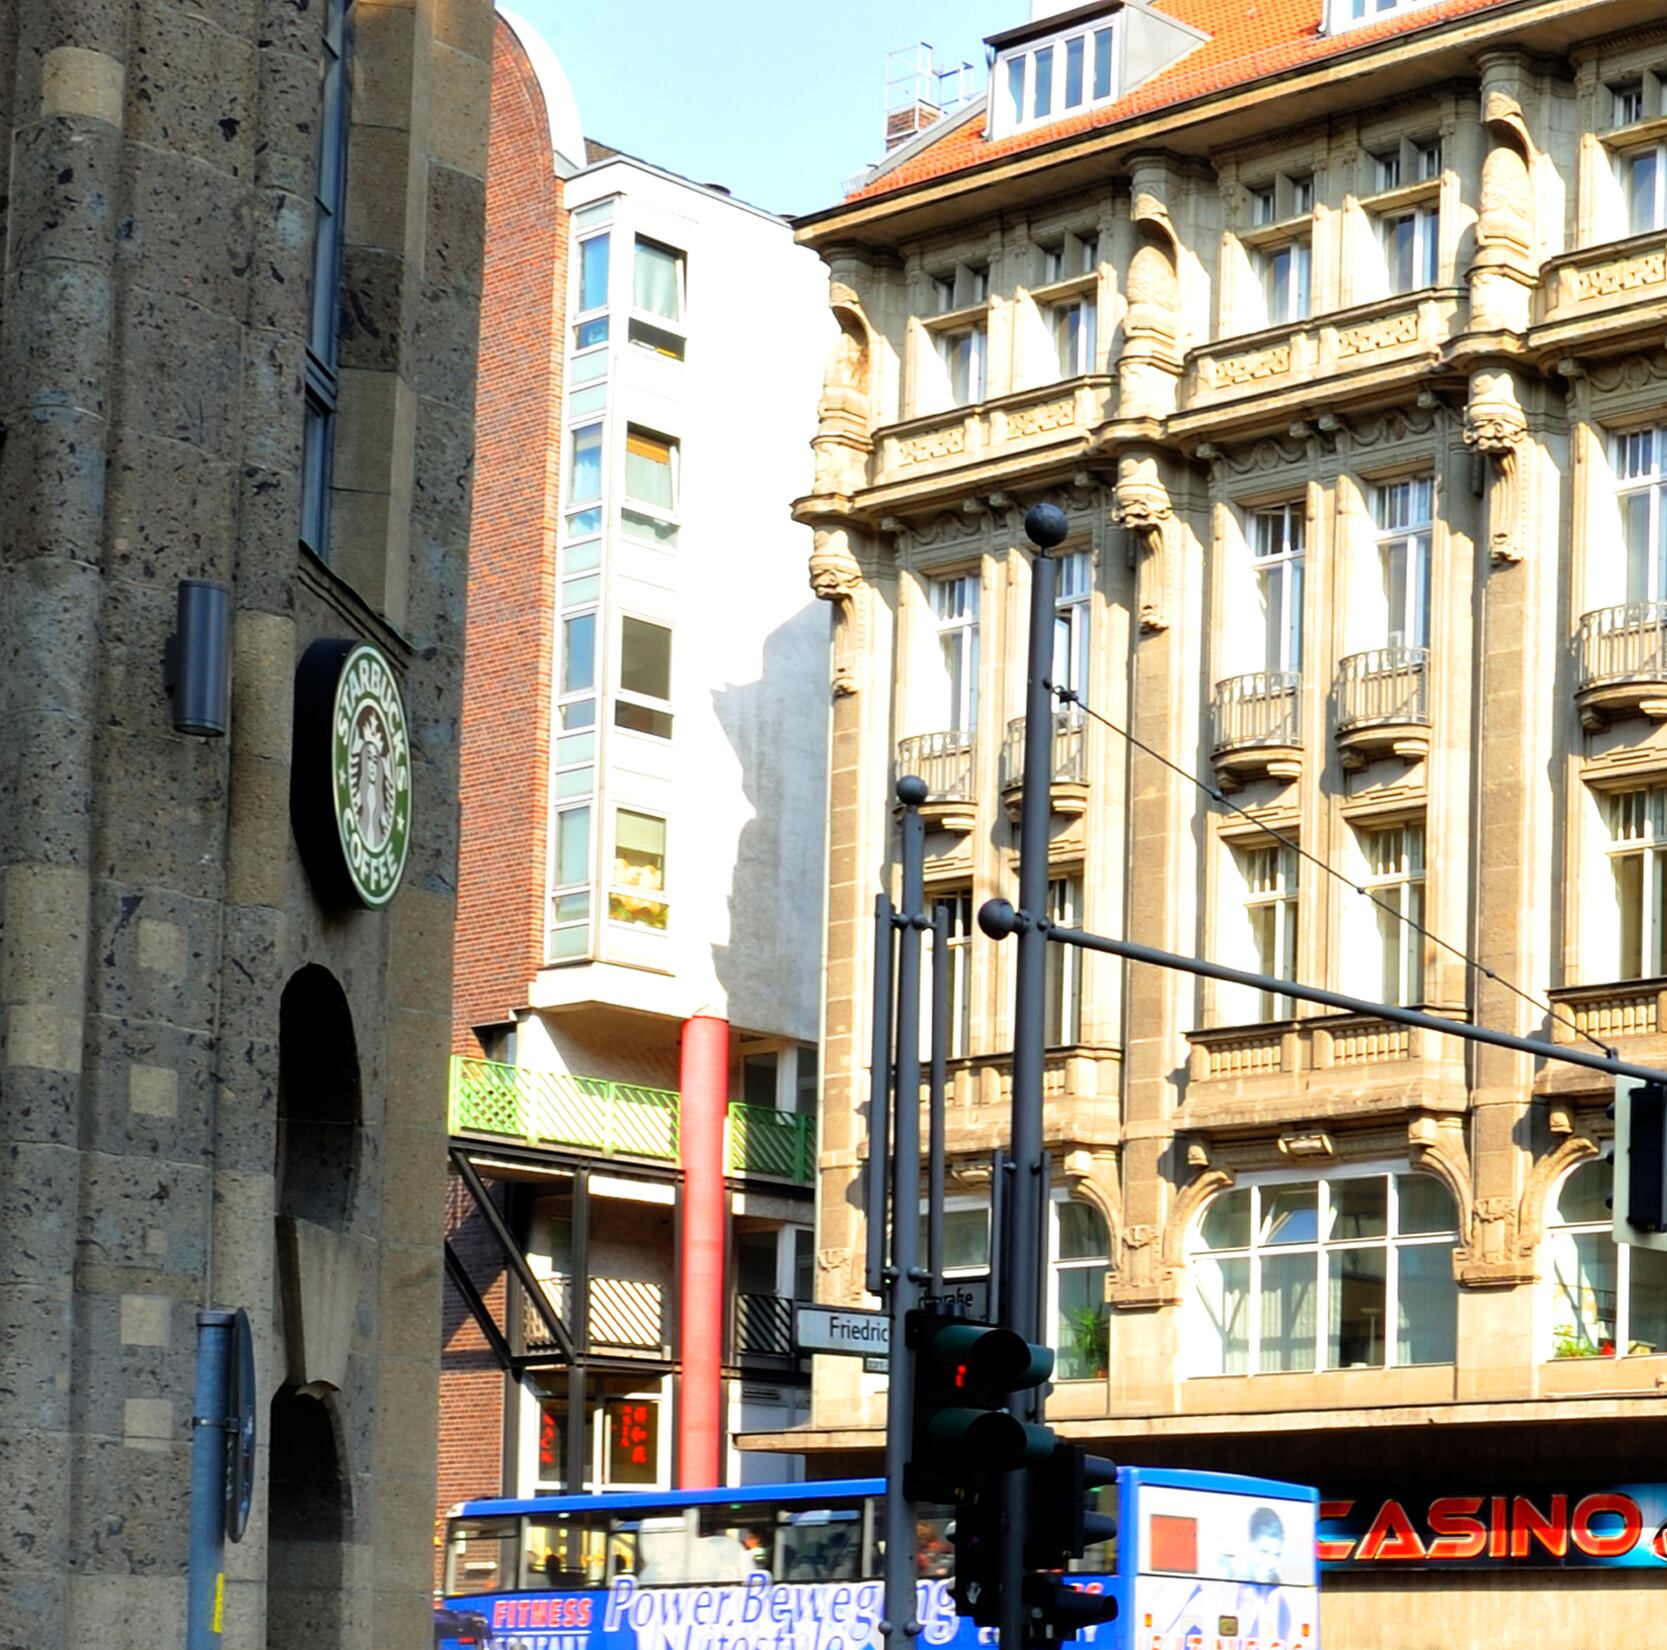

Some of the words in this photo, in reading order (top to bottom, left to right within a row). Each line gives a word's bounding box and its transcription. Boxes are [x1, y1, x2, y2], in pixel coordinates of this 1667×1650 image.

[337, 658, 407, 792] STARBUCKS
[343, 807, 398, 890] COFFEE
[829, 1315, 889, 1342] Friedric
[1316, 1493, 1644, 1560] CASINO
[494, 1599, 592, 1628] FITNESS
[741, 1573, 958, 1644] Bewegng
